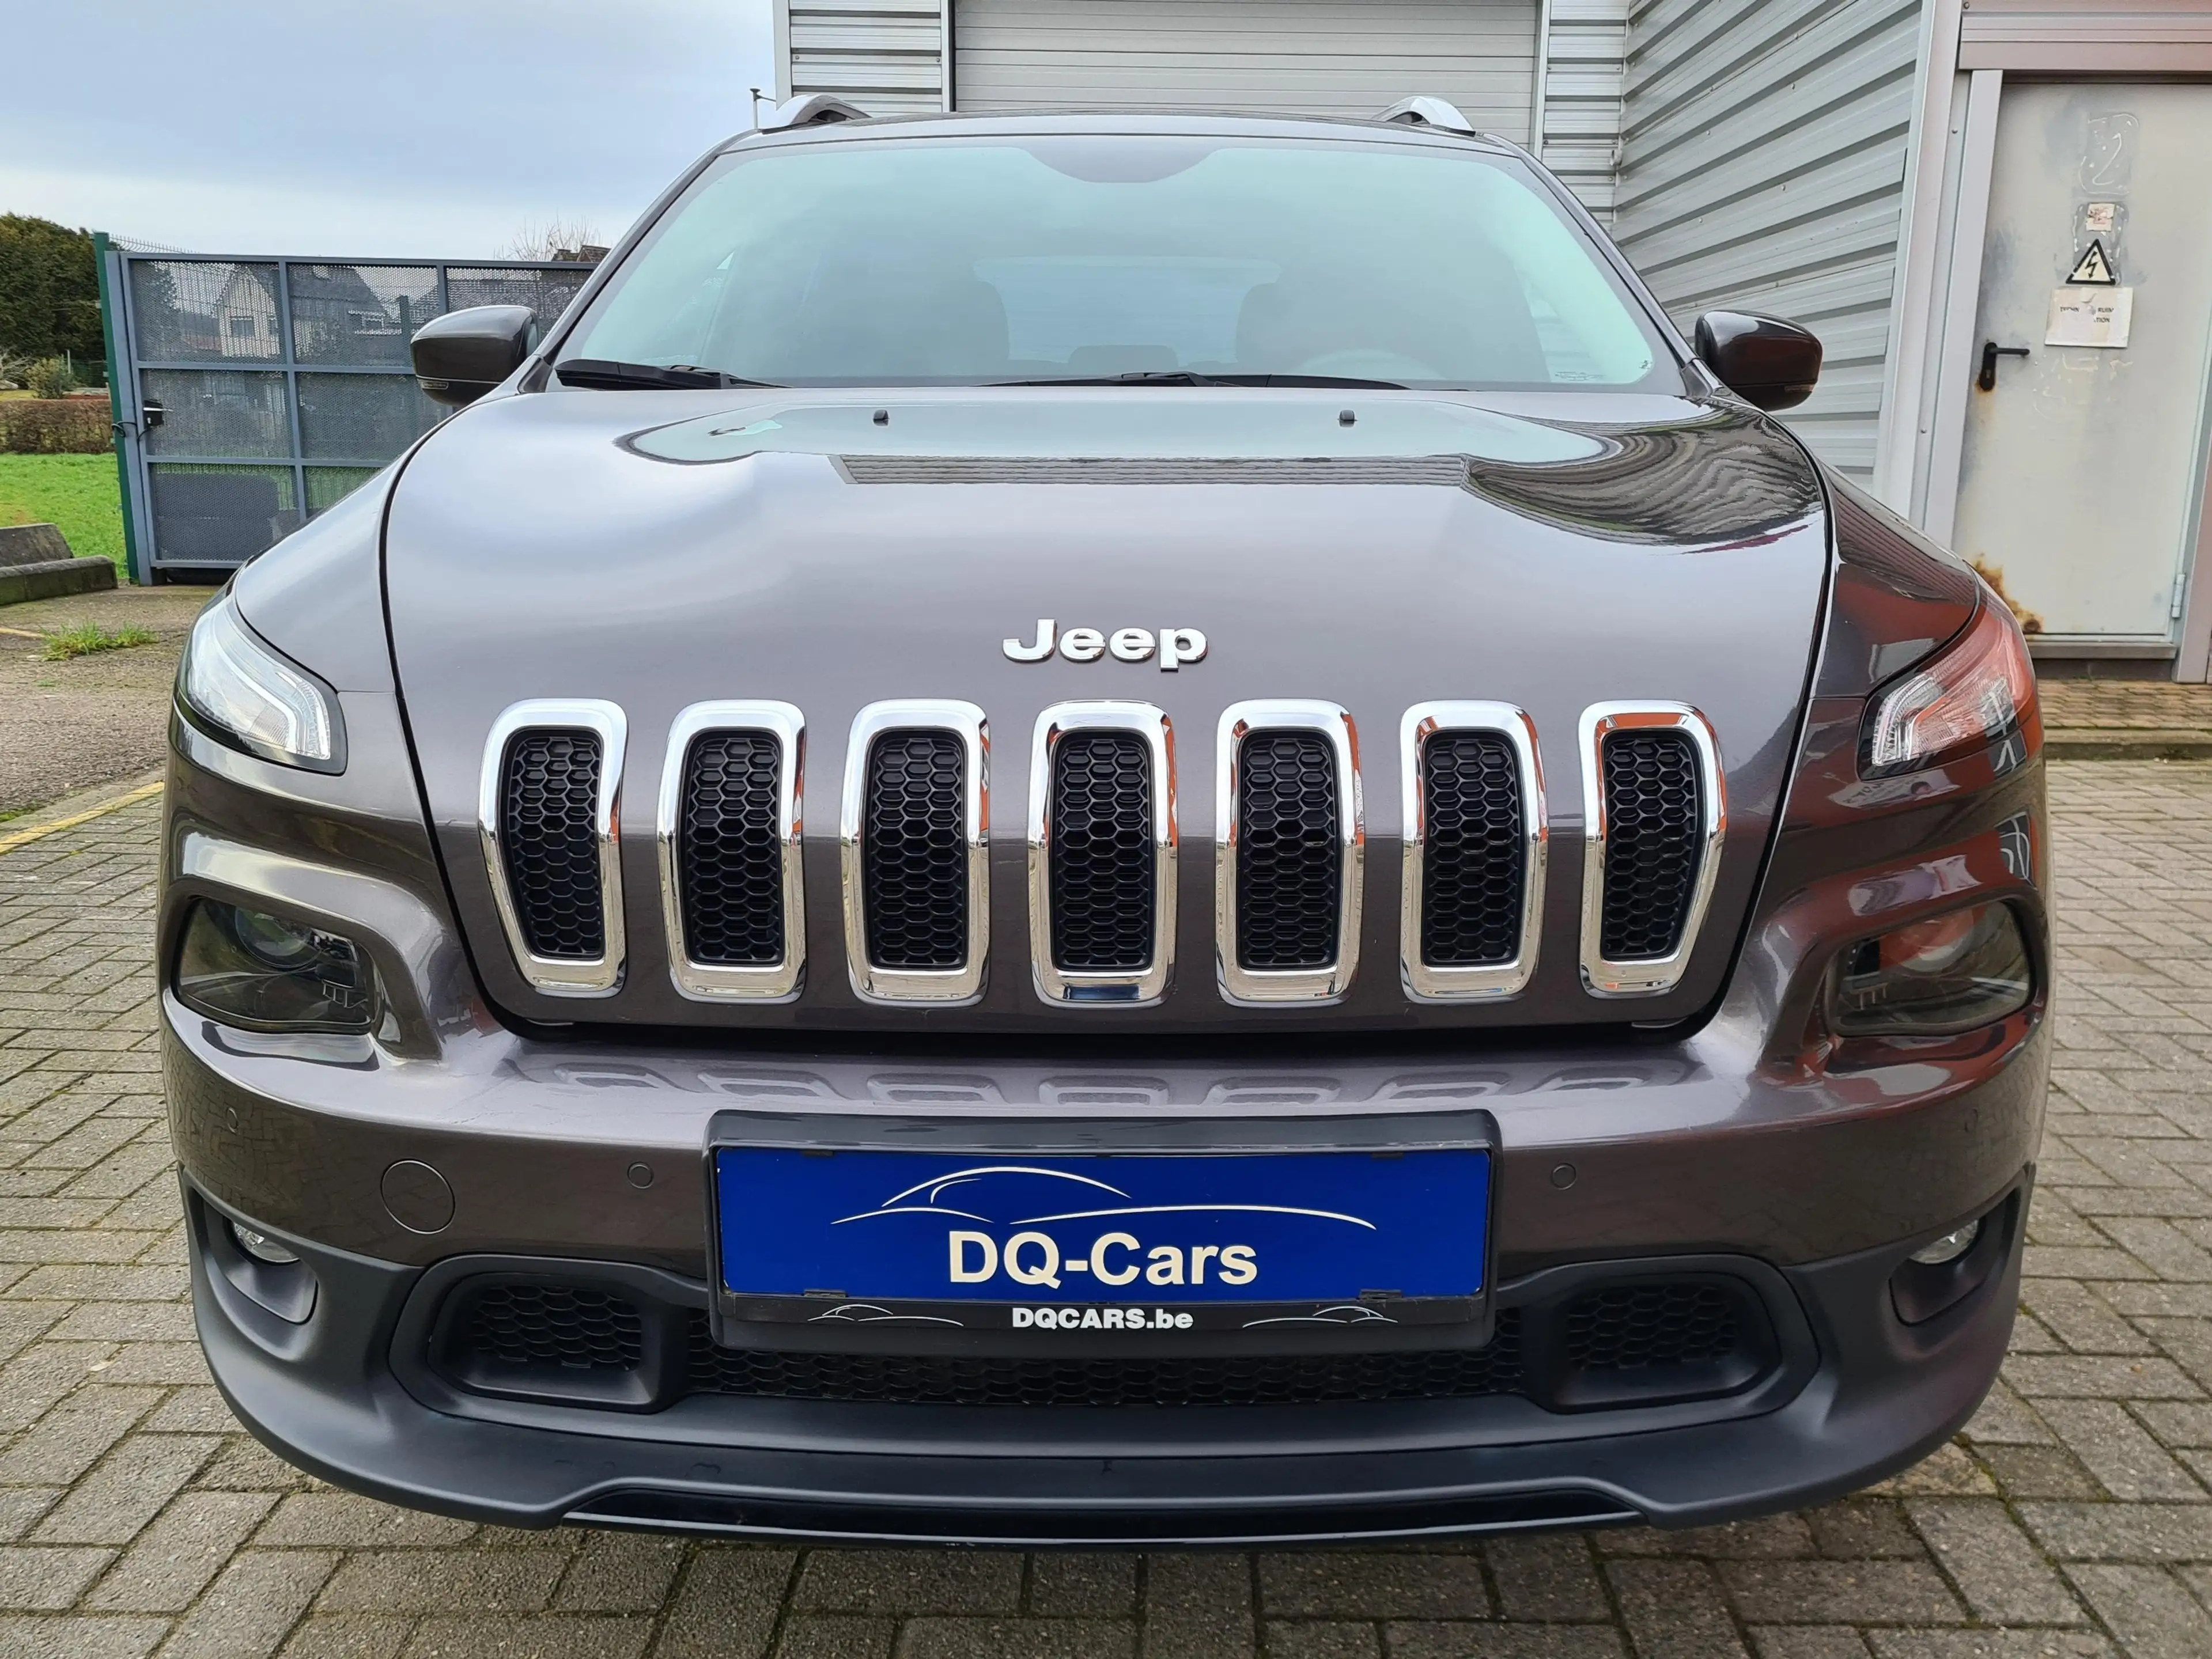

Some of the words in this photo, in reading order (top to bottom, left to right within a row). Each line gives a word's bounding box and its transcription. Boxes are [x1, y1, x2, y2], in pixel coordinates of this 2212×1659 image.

[1002, 618, 1208, 673] Jeep
[948, 1230, 1258, 1289] DQ-Cars
[1012, 1307, 1194, 1330] DQCARS.be
